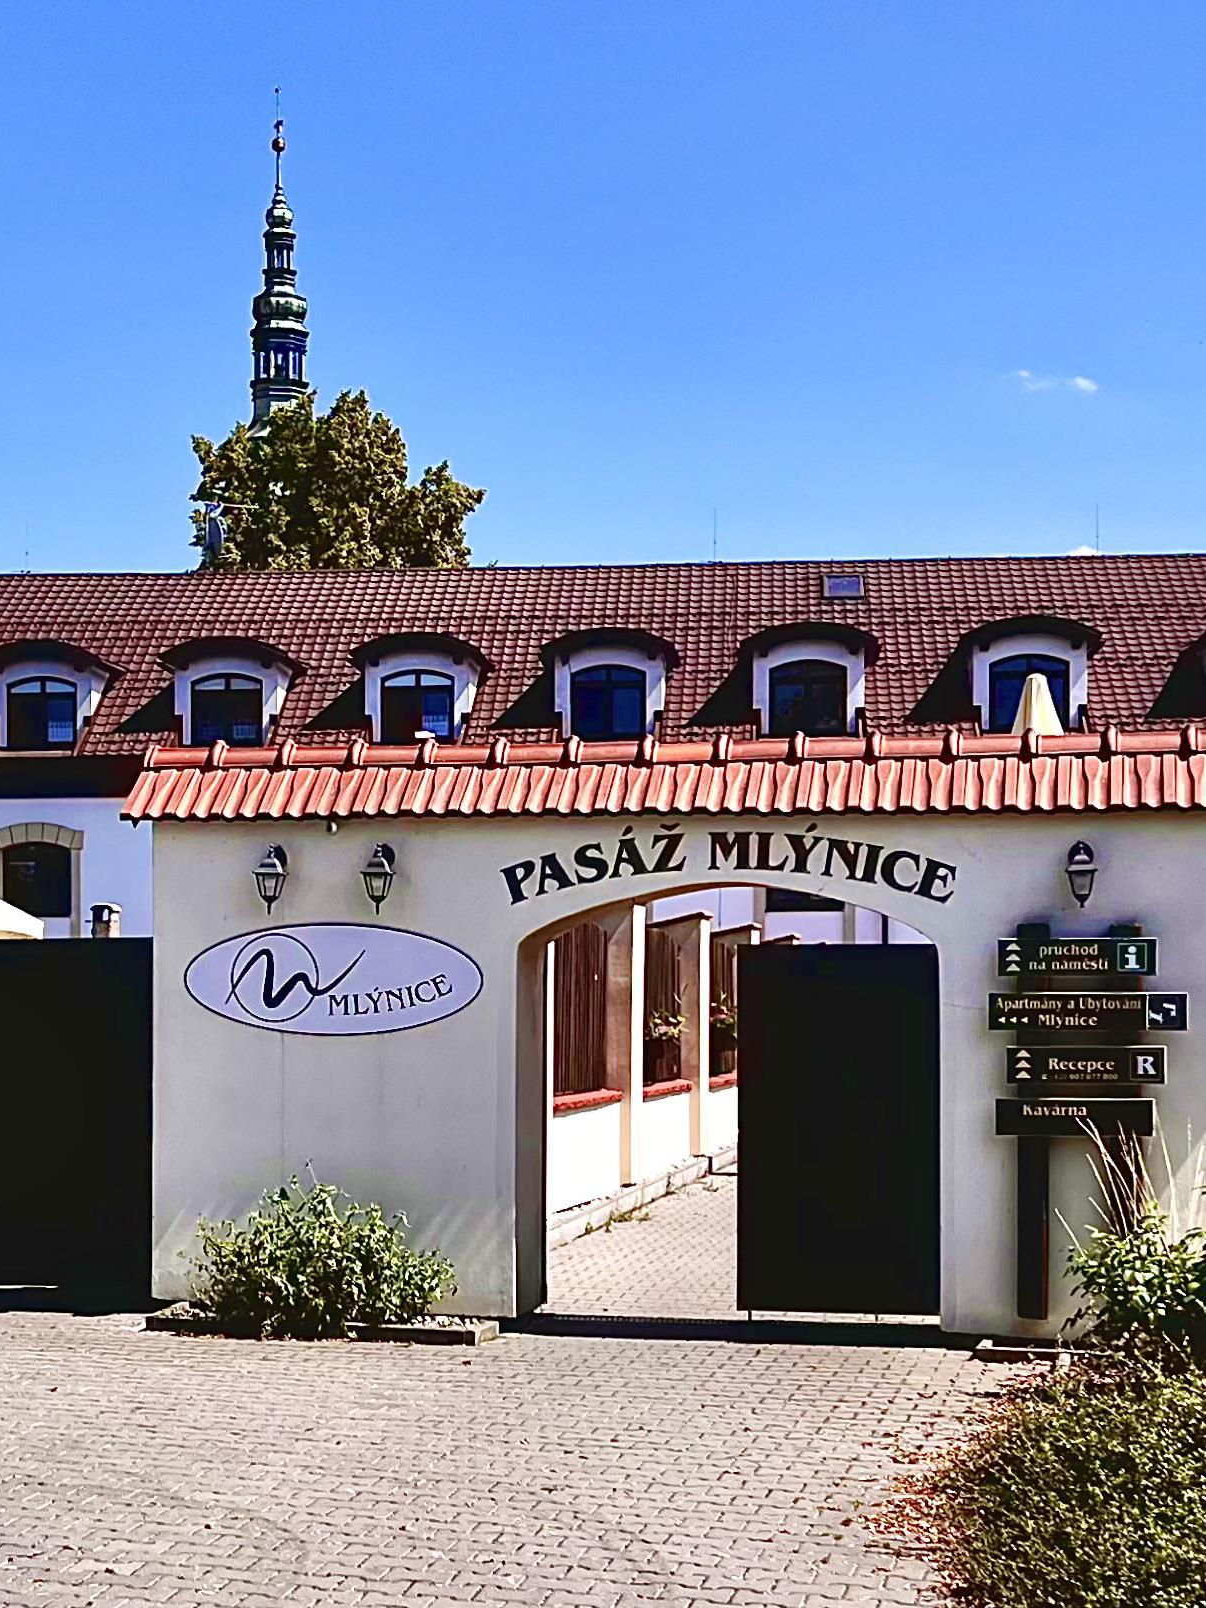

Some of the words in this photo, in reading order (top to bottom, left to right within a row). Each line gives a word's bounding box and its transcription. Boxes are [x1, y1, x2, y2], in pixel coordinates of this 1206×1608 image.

[499, 823, 687, 906] PASÁŽ
[708, 823, 957, 904] MLÝNICE
[1029, 958, 1046, 970] na
[328, 973, 453, 1016] MLÝNICE
[996, 997, 1062, 1012] Apartmány
[1067, 999, 1075, 1009] a
[1048, 1058, 1115, 1073] Recepce
[1136, 1055, 1157, 1075] R
[1023, 1104, 1087, 1116] Kavárna
